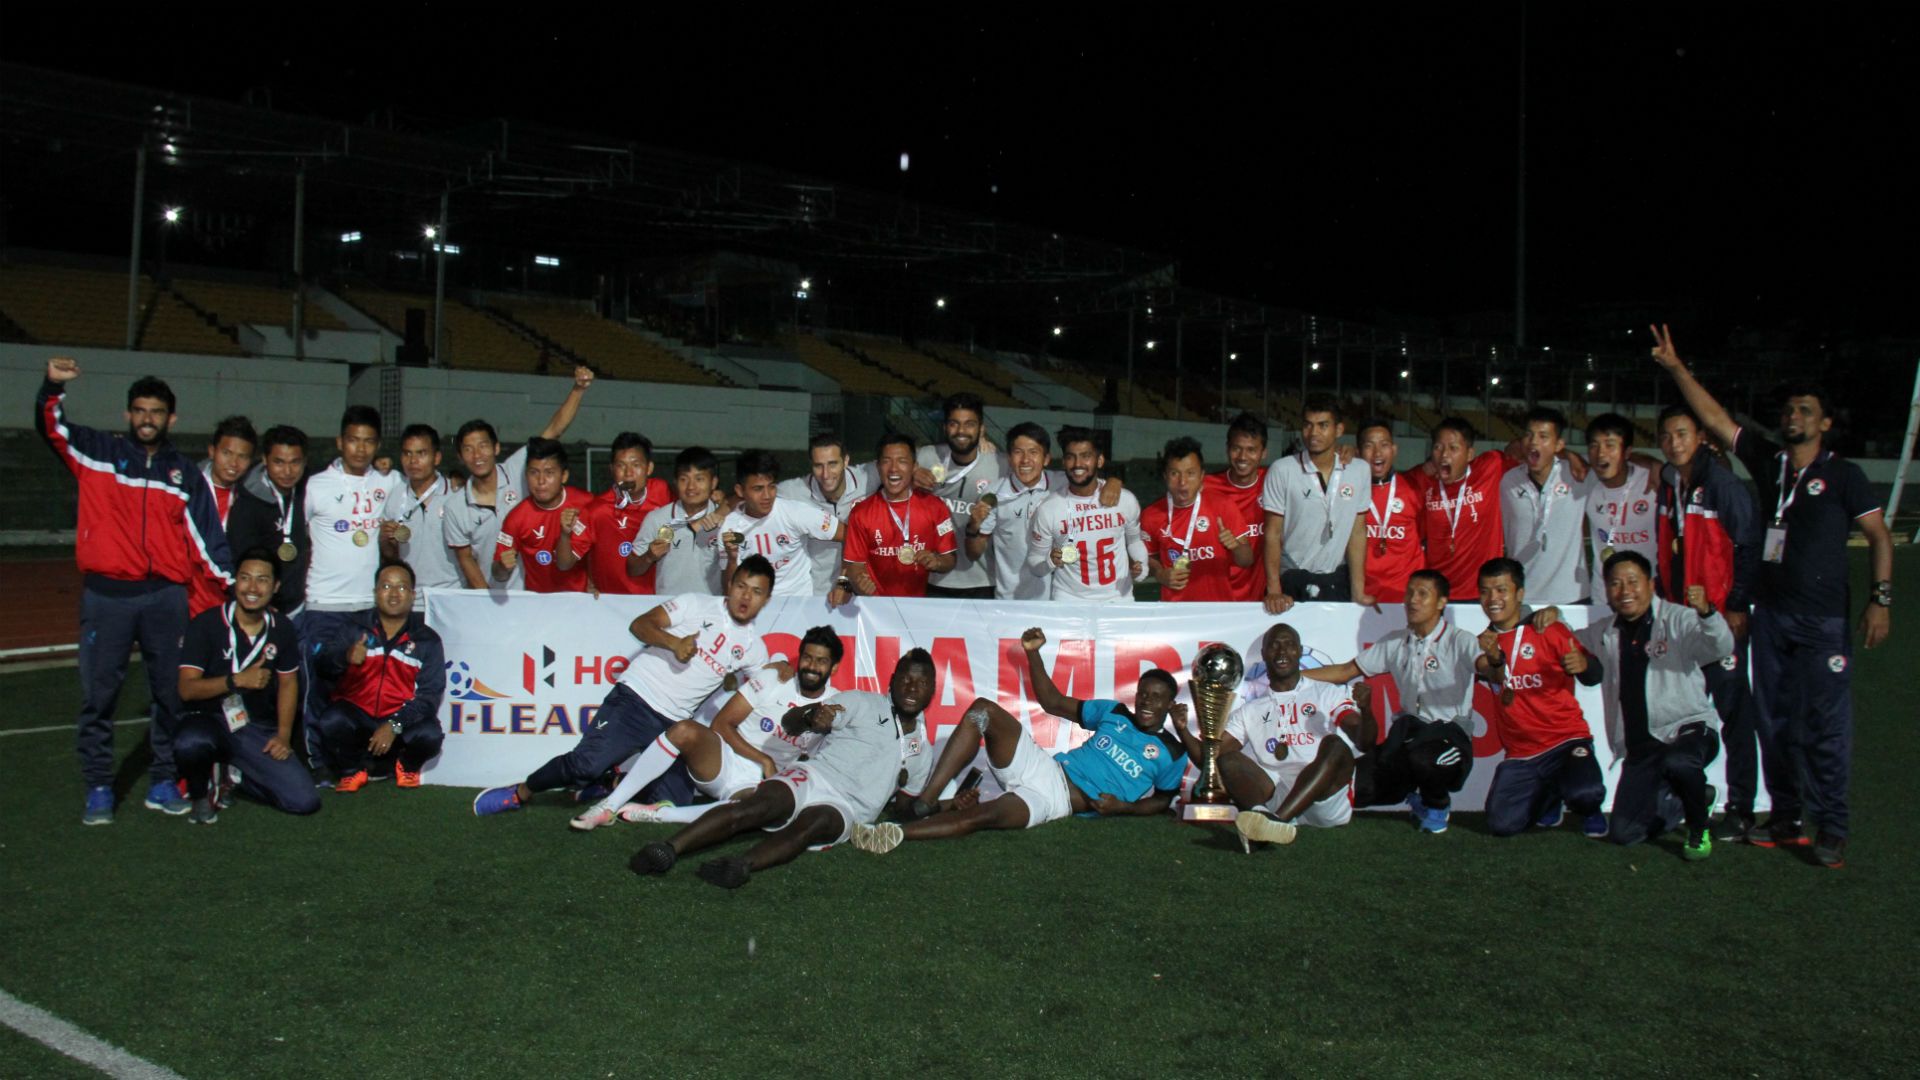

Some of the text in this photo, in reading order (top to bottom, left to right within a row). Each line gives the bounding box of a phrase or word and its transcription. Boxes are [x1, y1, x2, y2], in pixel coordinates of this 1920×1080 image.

[945, 498, 980, 516] NEC
[754, 532, 772, 556] 11
[1188, 545, 1215, 561] ECS
[1075, 537, 1117, 586] 16
[709, 633, 726, 655] 9
[1284, 733, 1315, 746] ECS
[1105, 743, 1143, 778] NECS
